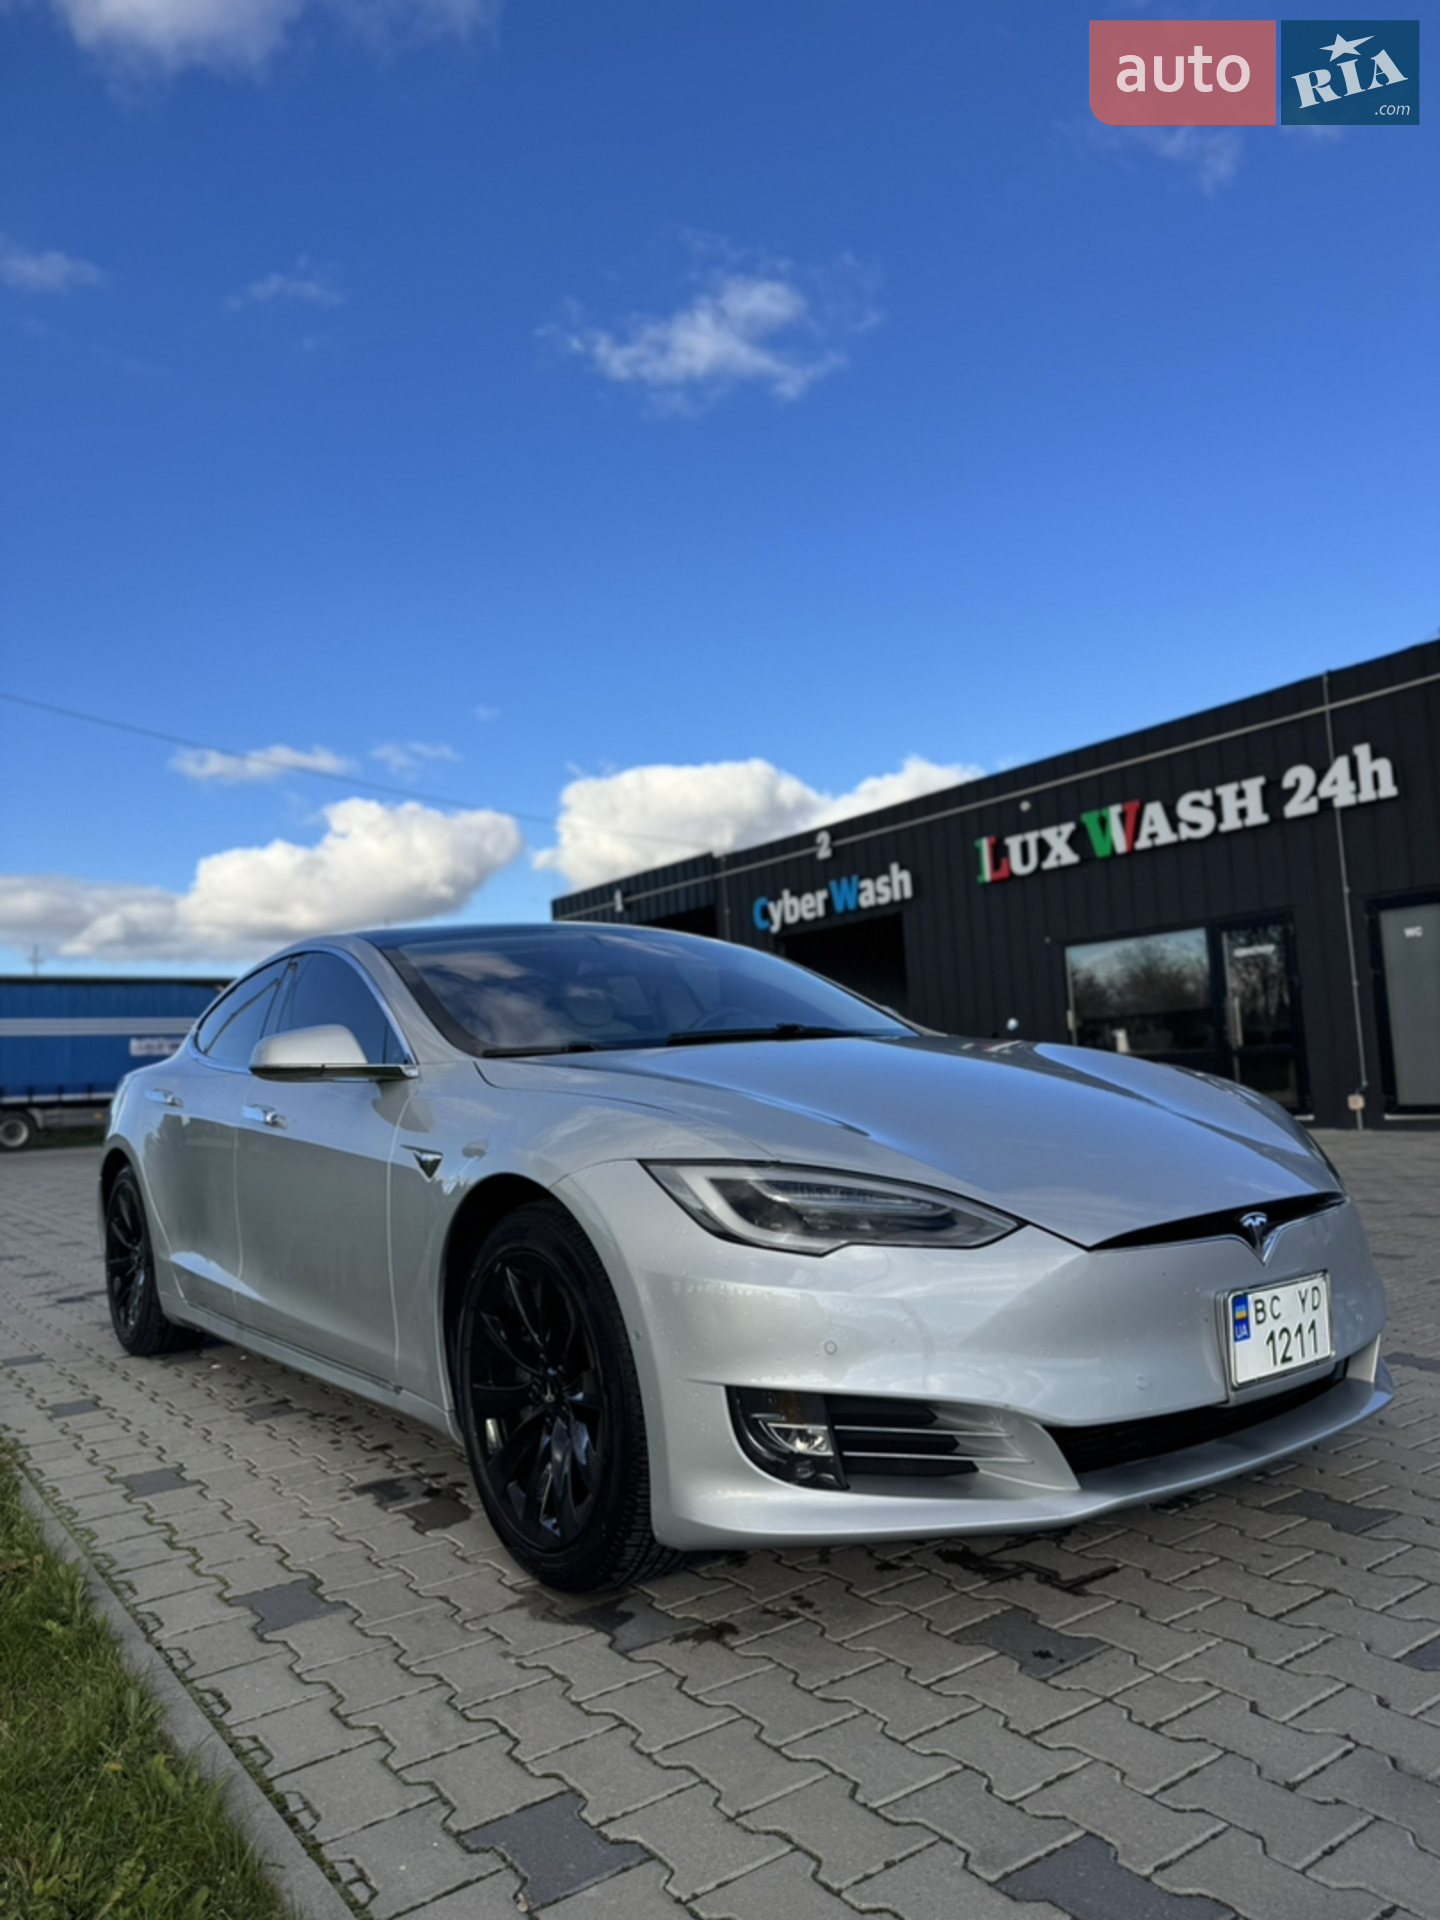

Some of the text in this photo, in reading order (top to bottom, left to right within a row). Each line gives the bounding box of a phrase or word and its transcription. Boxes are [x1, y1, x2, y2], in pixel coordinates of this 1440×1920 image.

[975, 742, 1398, 884] LUX WASH 24h
[816, 830, 832, 860] 2
[1254, 1286, 1321, 1325] BC YD
[1266, 1319, 1318, 1366] 1211
